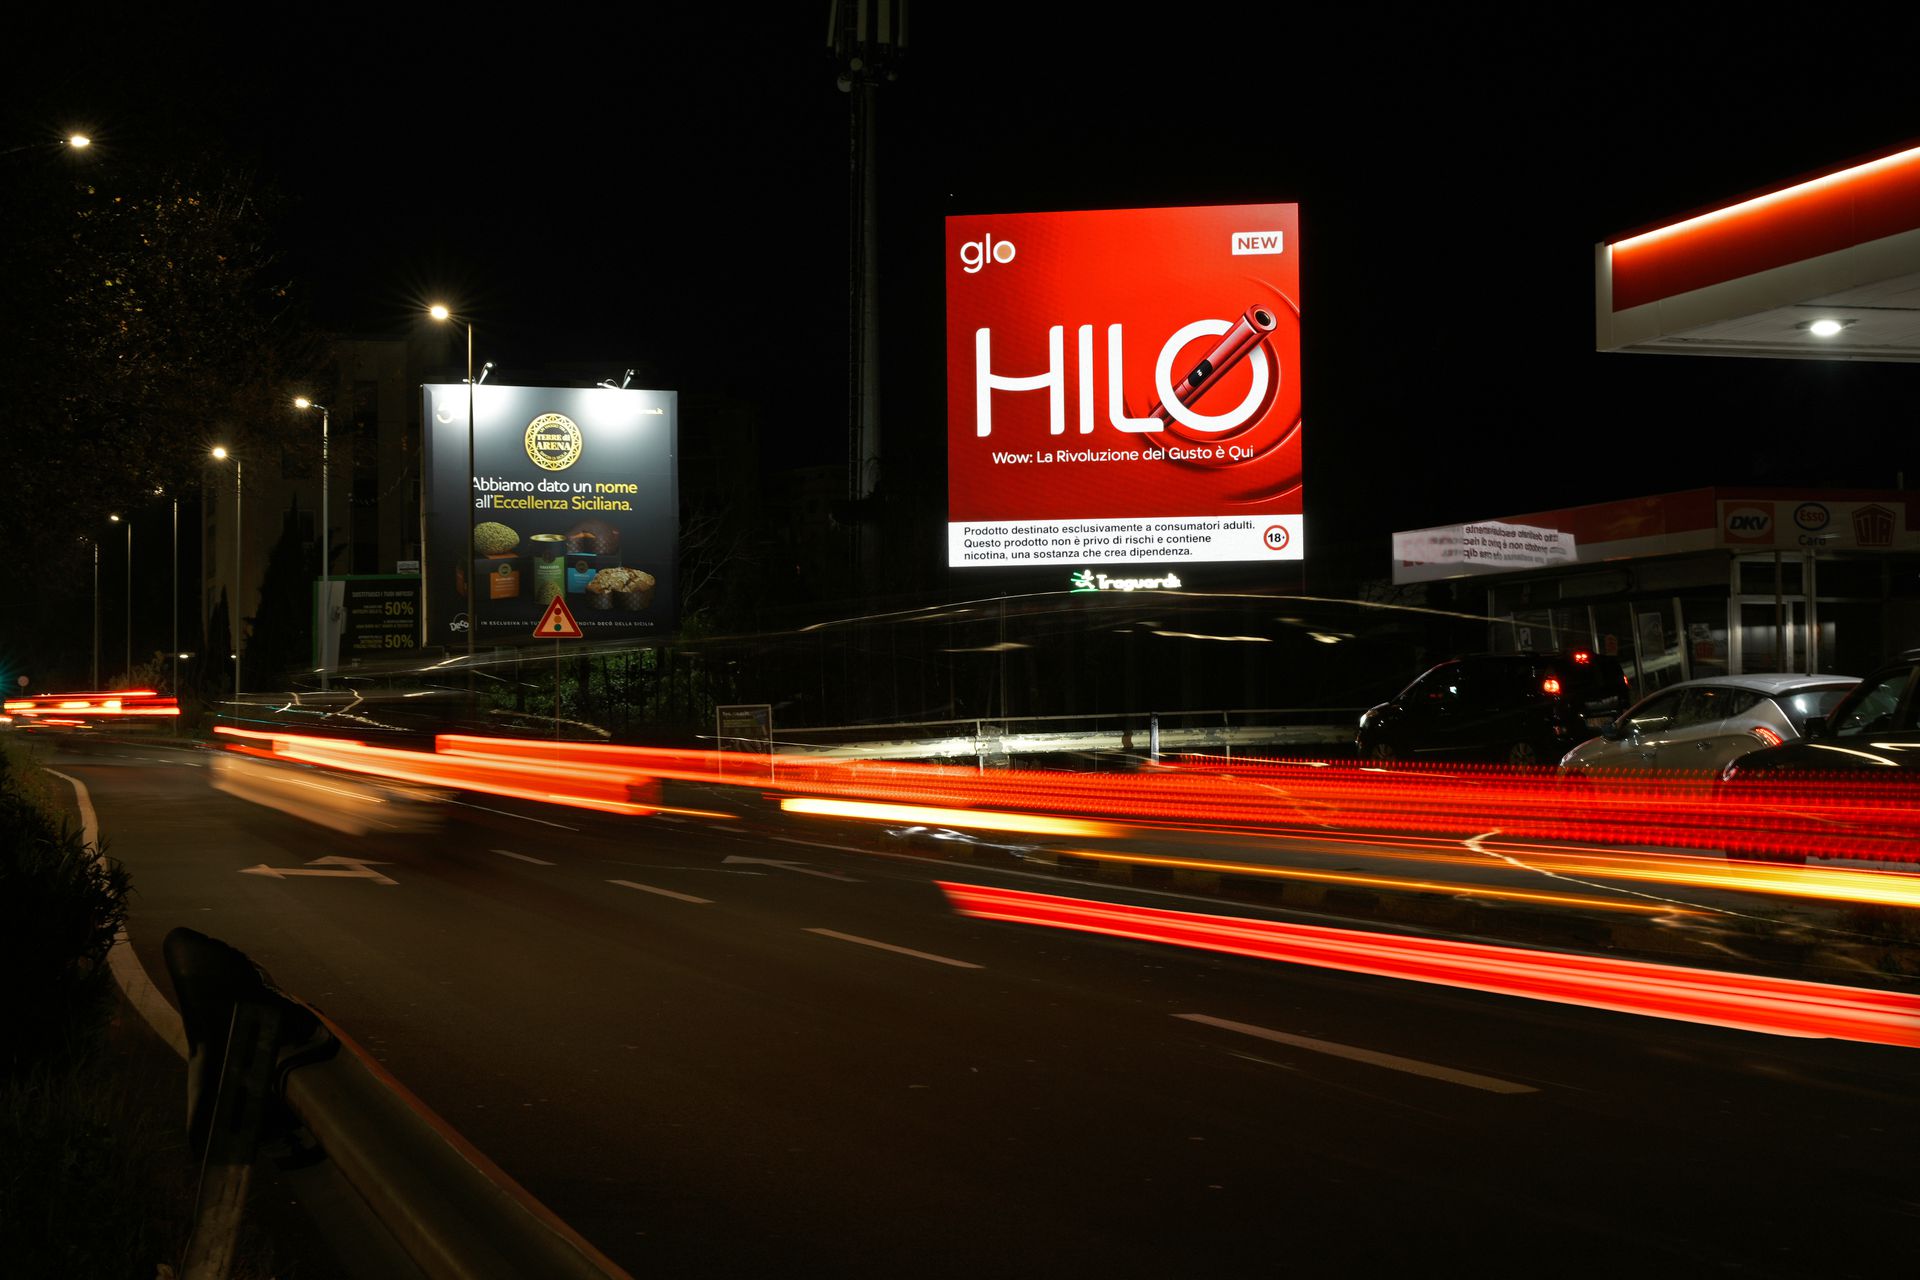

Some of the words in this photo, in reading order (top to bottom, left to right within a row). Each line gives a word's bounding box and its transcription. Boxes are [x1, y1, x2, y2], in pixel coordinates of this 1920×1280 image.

[1237, 236, 1279, 250] NEW
[960, 232, 1016, 274] glo
[975, 318, 1270, 438] HILO
[537, 433, 562, 441] TERRE
[537, 441, 571, 450] ARENA
[992, 451, 1033, 465] Wow:
[1036, 450, 1053, 463] La
[1056, 448, 1139, 463] Rivoluzione
[1142, 447, 1165, 461] del
[1168, 446, 1213, 460] Gusto
[1215, 445, 1225, 459] è
[1228, 445, 1254, 461] Qui
[473, 477, 534, 492] Abbiamo
[537, 478, 570, 493] dato
[573, 482, 592, 493] un
[595, 482, 638, 494] nome
[571, 496, 633, 511] Siciliana.
[1729, 515, 1769, 530] DKV
[1799, 508, 1825, 522] Esso
[965, 526, 1009, 536] Prodotto
[1011, 525, 1059, 536] destinato
[1062, 523, 1143, 535] esclusivamente
[1145, 524, 1152, 532] a
[1154, 521, 1220, 532] consumatori
[1223, 520, 1255, 531] adulti.
[964, 538, 1001, 548] Questo
[1004, 537, 1048, 549] prodotto
[1073, 537, 1080, 546] è
[1083, 536, 1110, 548] privo
[1112, 535, 1122, 545] di
[1125, 534, 1154, 545] rischi
[1157, 536, 1163, 544] e
[1166, 534, 1212, 544] contiene
[964, 551, 1008, 562] nicotina,
[1011, 551, 1031, 559] una
[1033, 550, 1080, 559] sostanza
[1082, 548, 1102, 558] che
[1104, 549, 1127, 557] crea
[1129, 547, 1193, 559] dipendenza.
[384, 601, 414, 616] 50%
[384, 634, 414, 648] 50%
